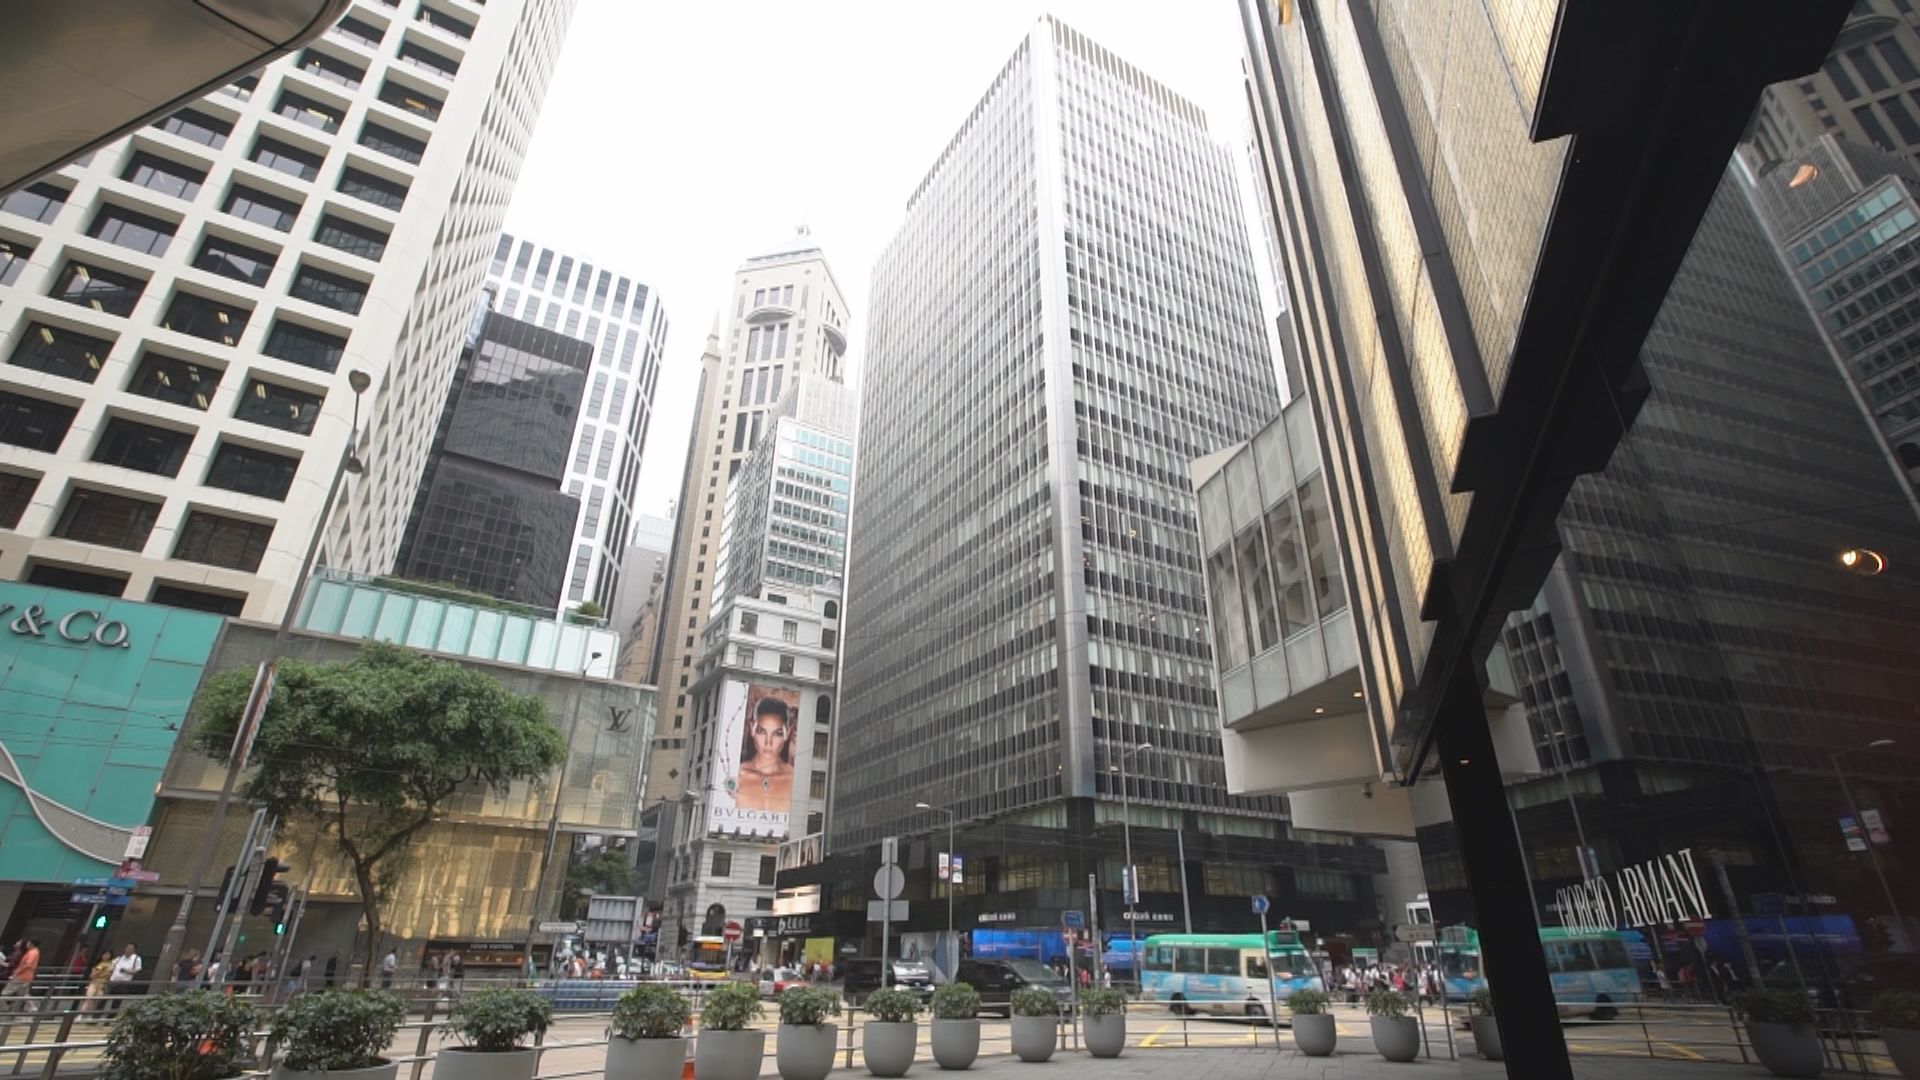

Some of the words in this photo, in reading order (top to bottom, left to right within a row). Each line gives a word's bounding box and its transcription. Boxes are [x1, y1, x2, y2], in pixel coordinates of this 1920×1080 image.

[10, 604, 52, 636] &
[714, 807, 788, 823] BVLGARI
[1555, 876, 1618, 938] GIORGIO
[1616, 848, 1712, 929] ARMANI
